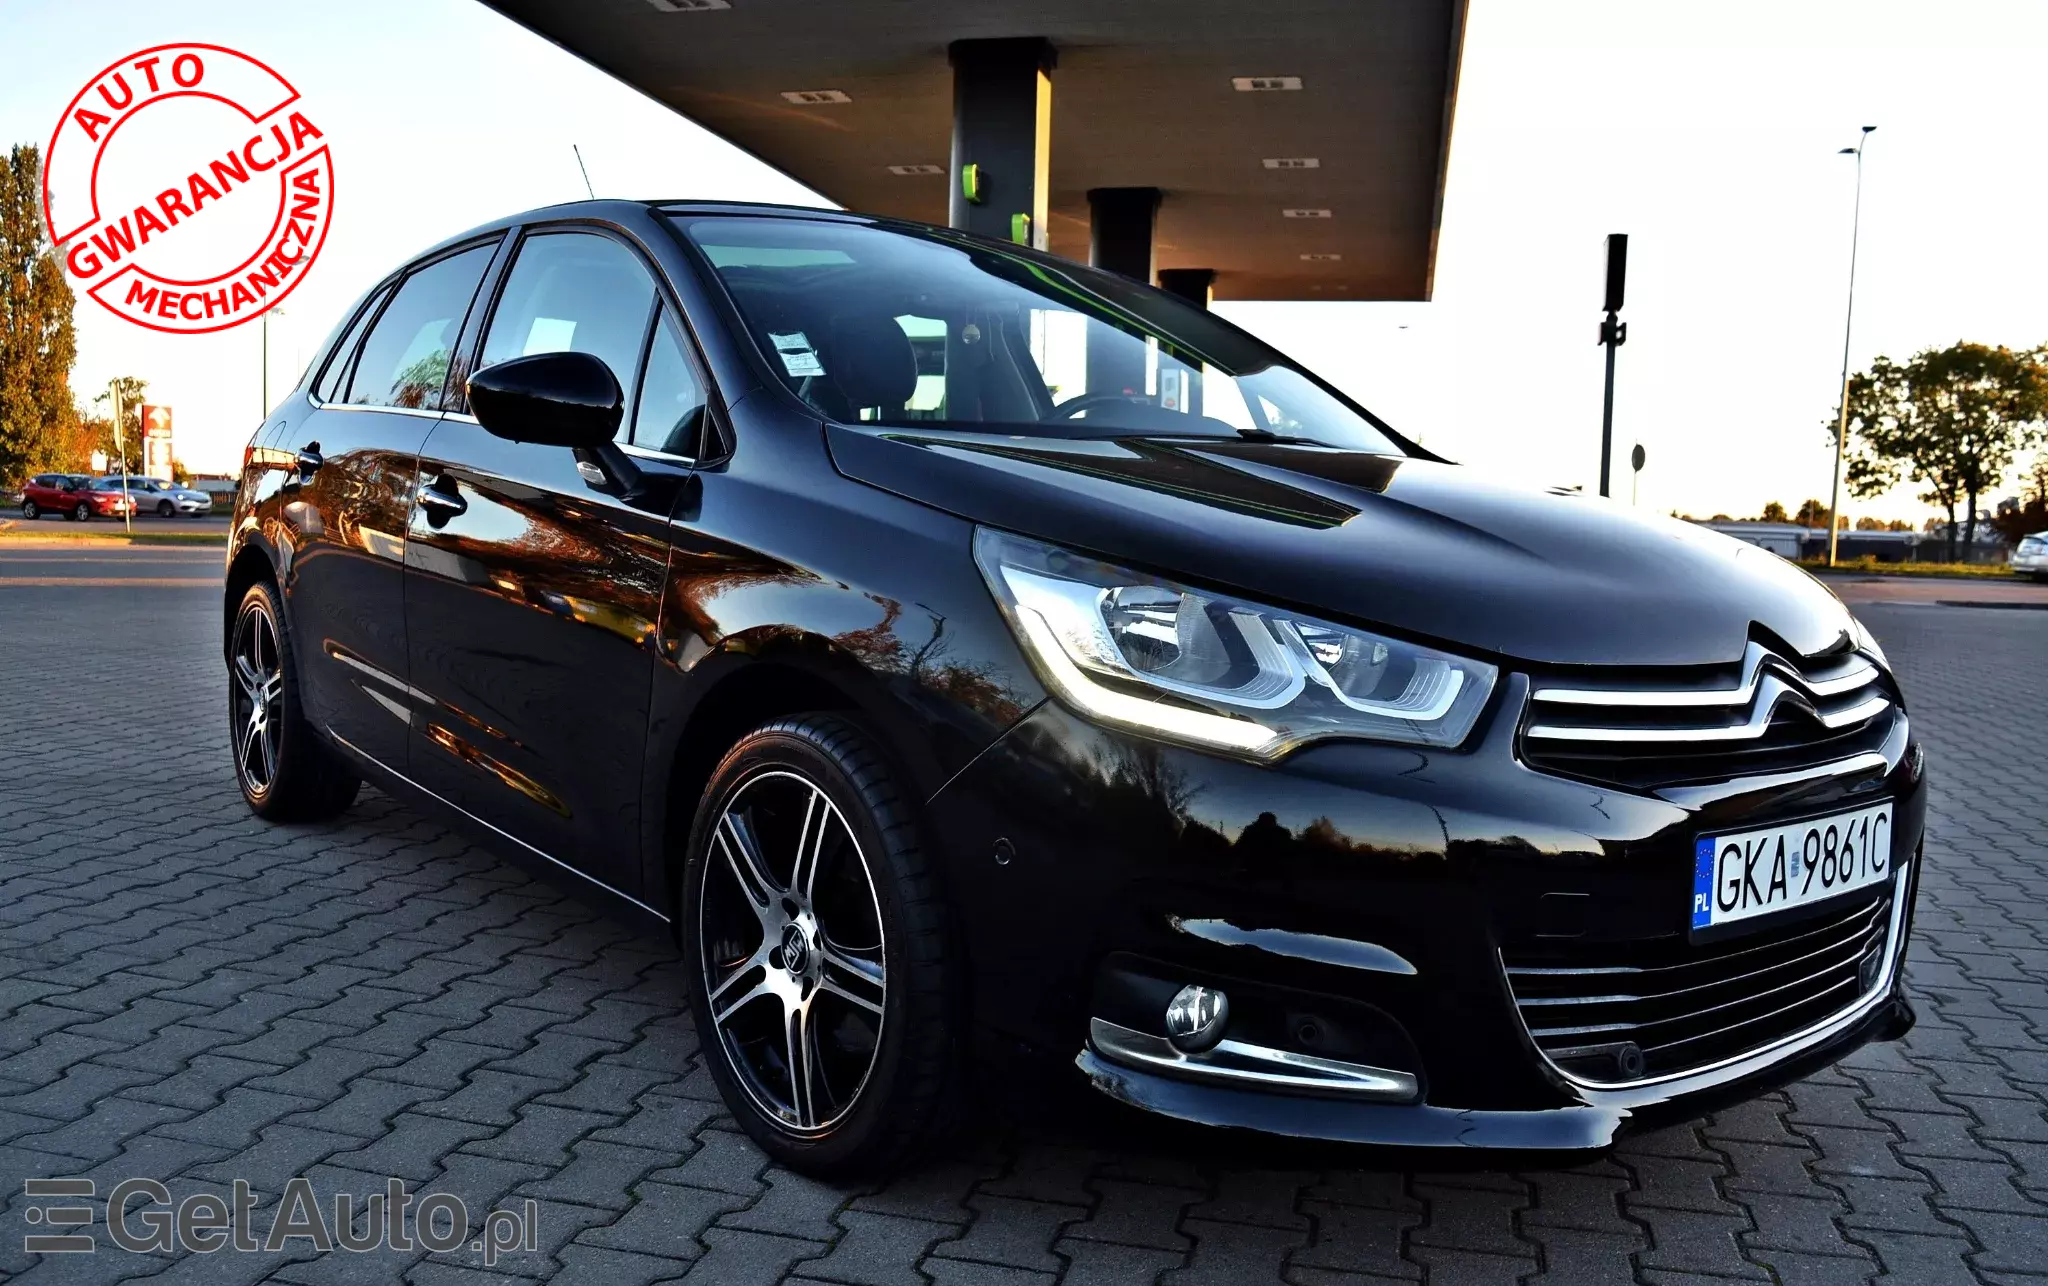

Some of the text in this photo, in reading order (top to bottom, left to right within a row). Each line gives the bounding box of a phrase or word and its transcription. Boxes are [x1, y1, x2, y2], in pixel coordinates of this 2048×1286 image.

[1716, 811, 1888, 913] GKA 9861C
[1694, 892, 1710, 914] PL
